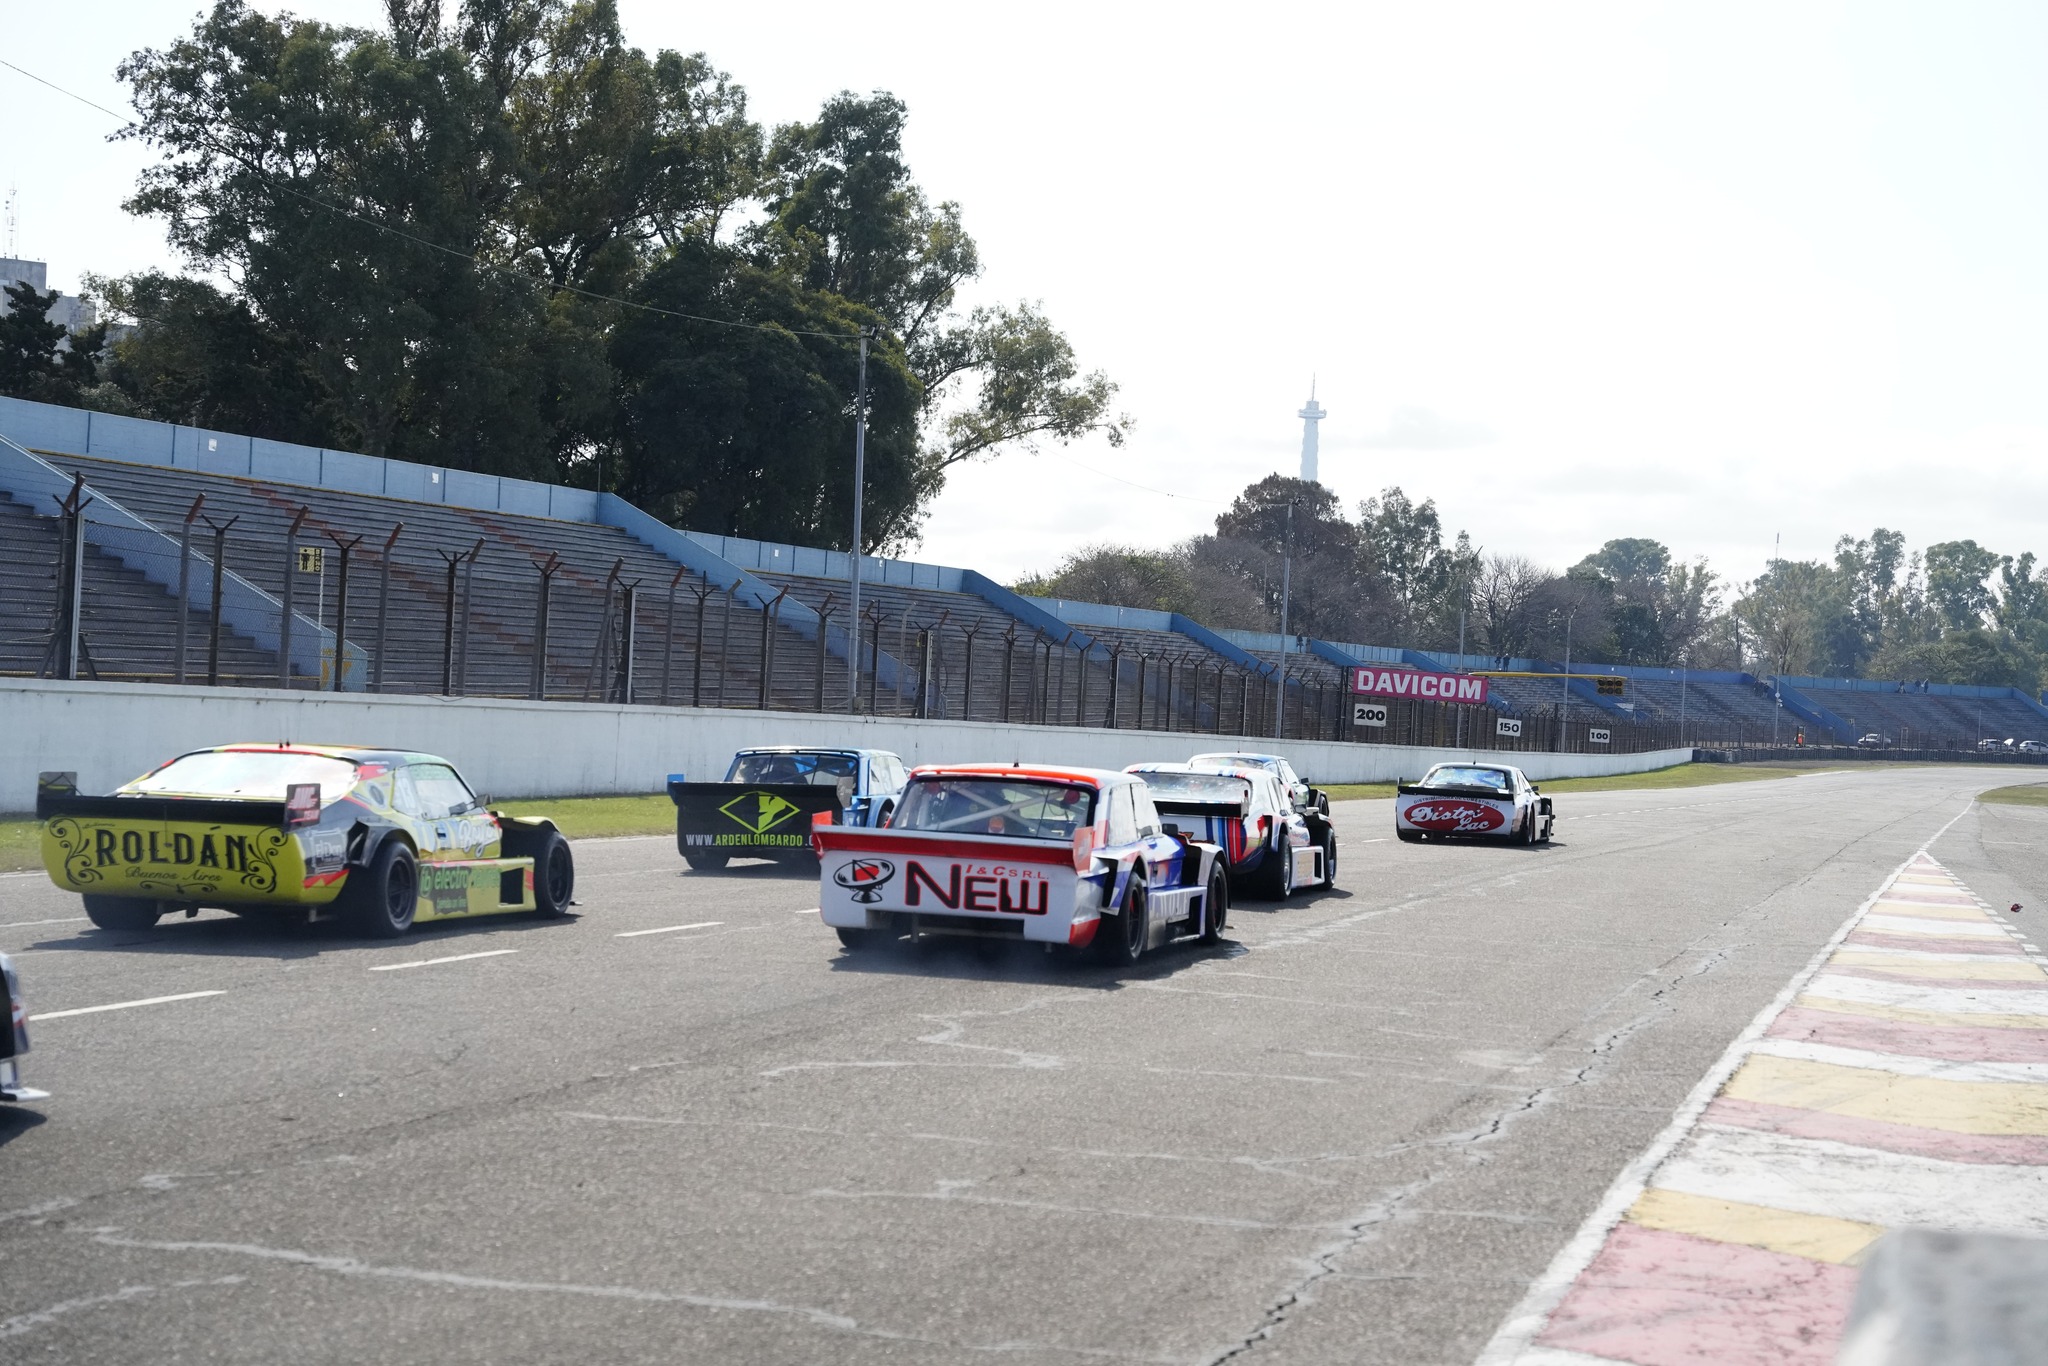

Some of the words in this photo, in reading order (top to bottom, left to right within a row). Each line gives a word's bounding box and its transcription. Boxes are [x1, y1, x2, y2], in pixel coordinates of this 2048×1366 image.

[1357, 670, 1482, 700] DAVICOM
[1356, 708, 1386, 721] 200
[1499, 722, 1520, 733] 150
[1591, 732, 1609, 740] 100
[1410, 805, 1484, 822] Distri
[1453, 817, 1489, 831] Lac
[95, 825, 249, 873] ROLDÁN
[125, 866, 178, 879] Buenos
[182, 869, 223, 881] Aires
[434, 866, 469, 889] electro
